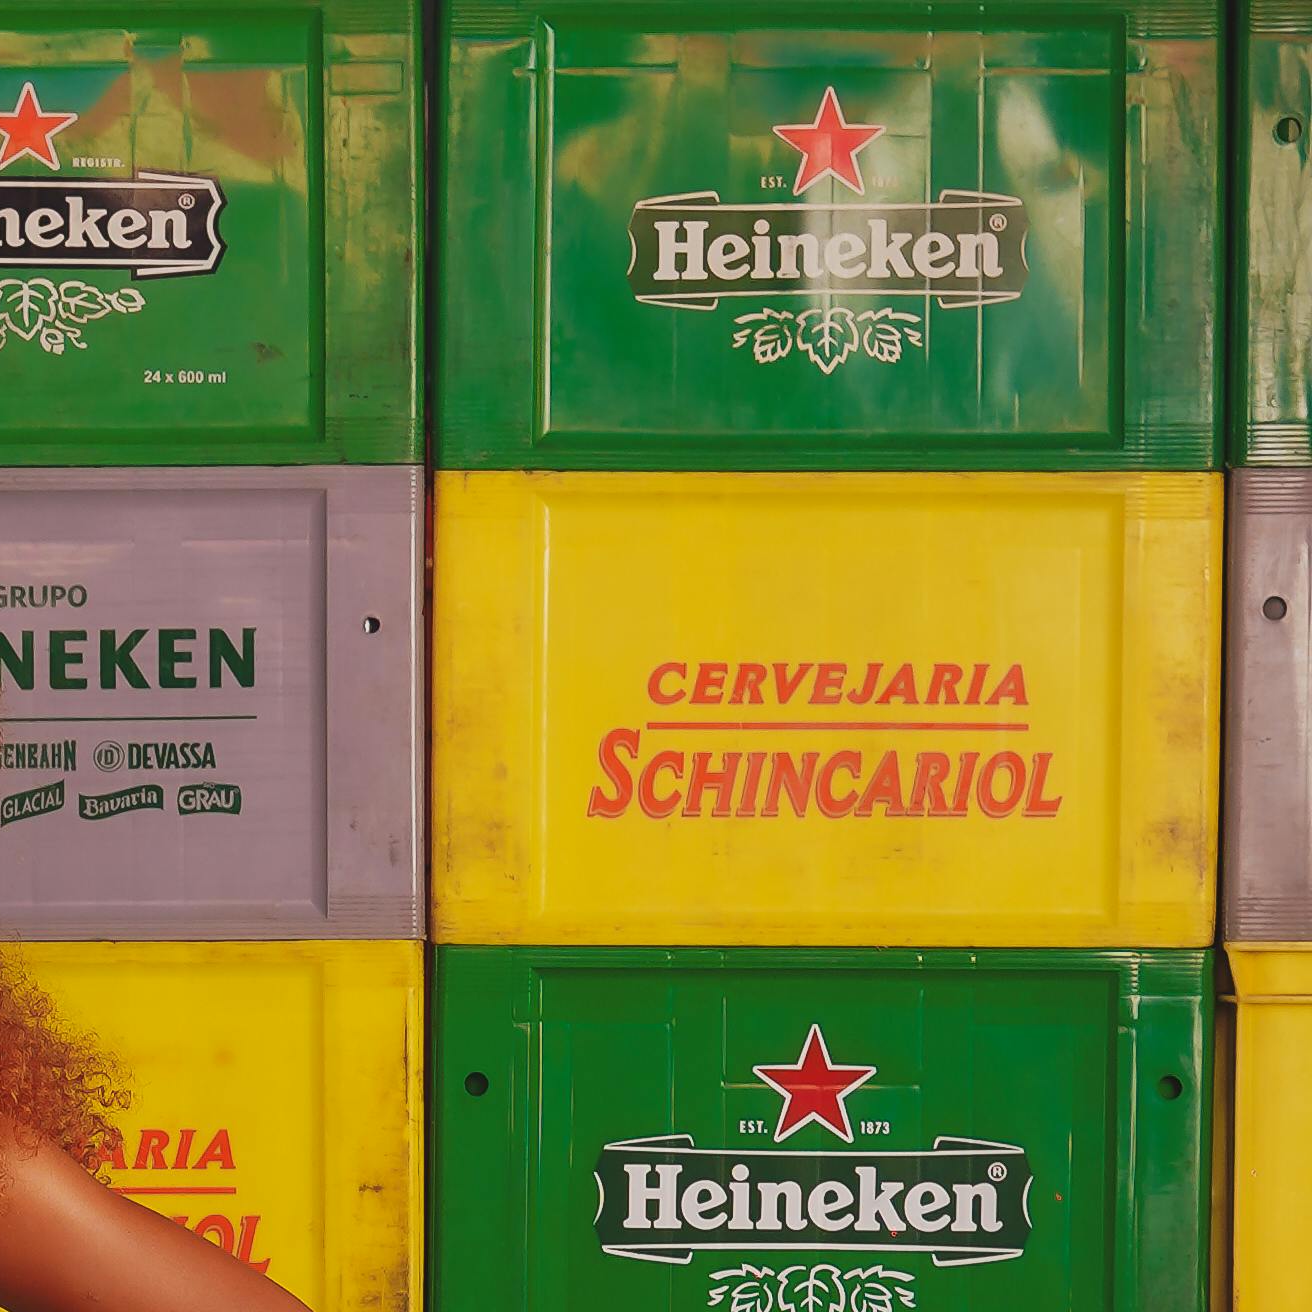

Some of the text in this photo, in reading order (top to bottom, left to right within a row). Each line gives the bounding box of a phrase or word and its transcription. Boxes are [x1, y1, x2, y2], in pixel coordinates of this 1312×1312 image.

[760, 175, 787, 188] EST.
[143, 370, 226, 383] 24 x 600 ml
[647, 662, 1029, 705] CERVEJARIA
[128, 743, 216, 769] DEVASSA
[587, 728, 1063, 819] SCHINCARIOL
[2, 788, 63, 818] GLACIAL
[84, 788, 158, 817] Bavaria
[739, 1120, 890, 1135] EST. 1873
